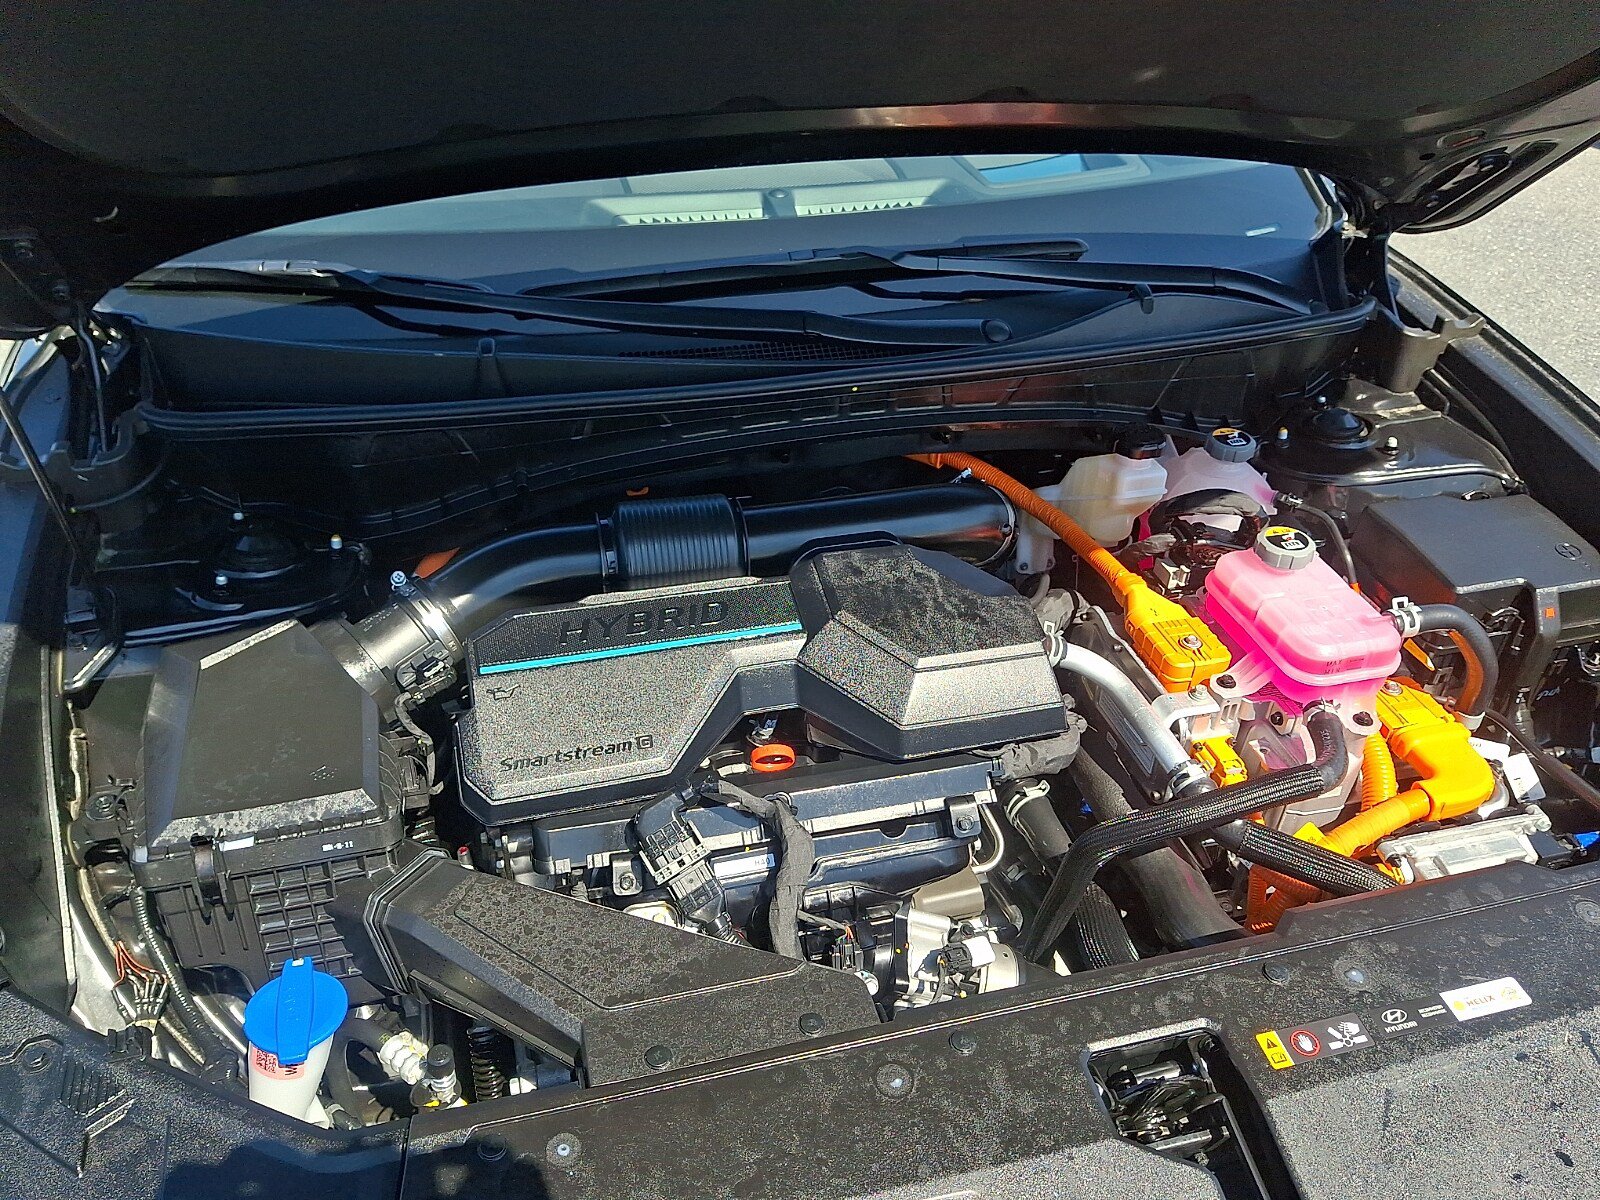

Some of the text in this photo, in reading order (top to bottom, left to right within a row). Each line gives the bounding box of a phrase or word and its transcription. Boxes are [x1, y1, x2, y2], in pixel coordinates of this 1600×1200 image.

[559, 600, 728, 646] HYBRID
[499, 735, 652, 772] Smartstream G
[1466, 995, 1496, 1007] HELIX
[1384, 1020, 1418, 1034] HYUNDAI
